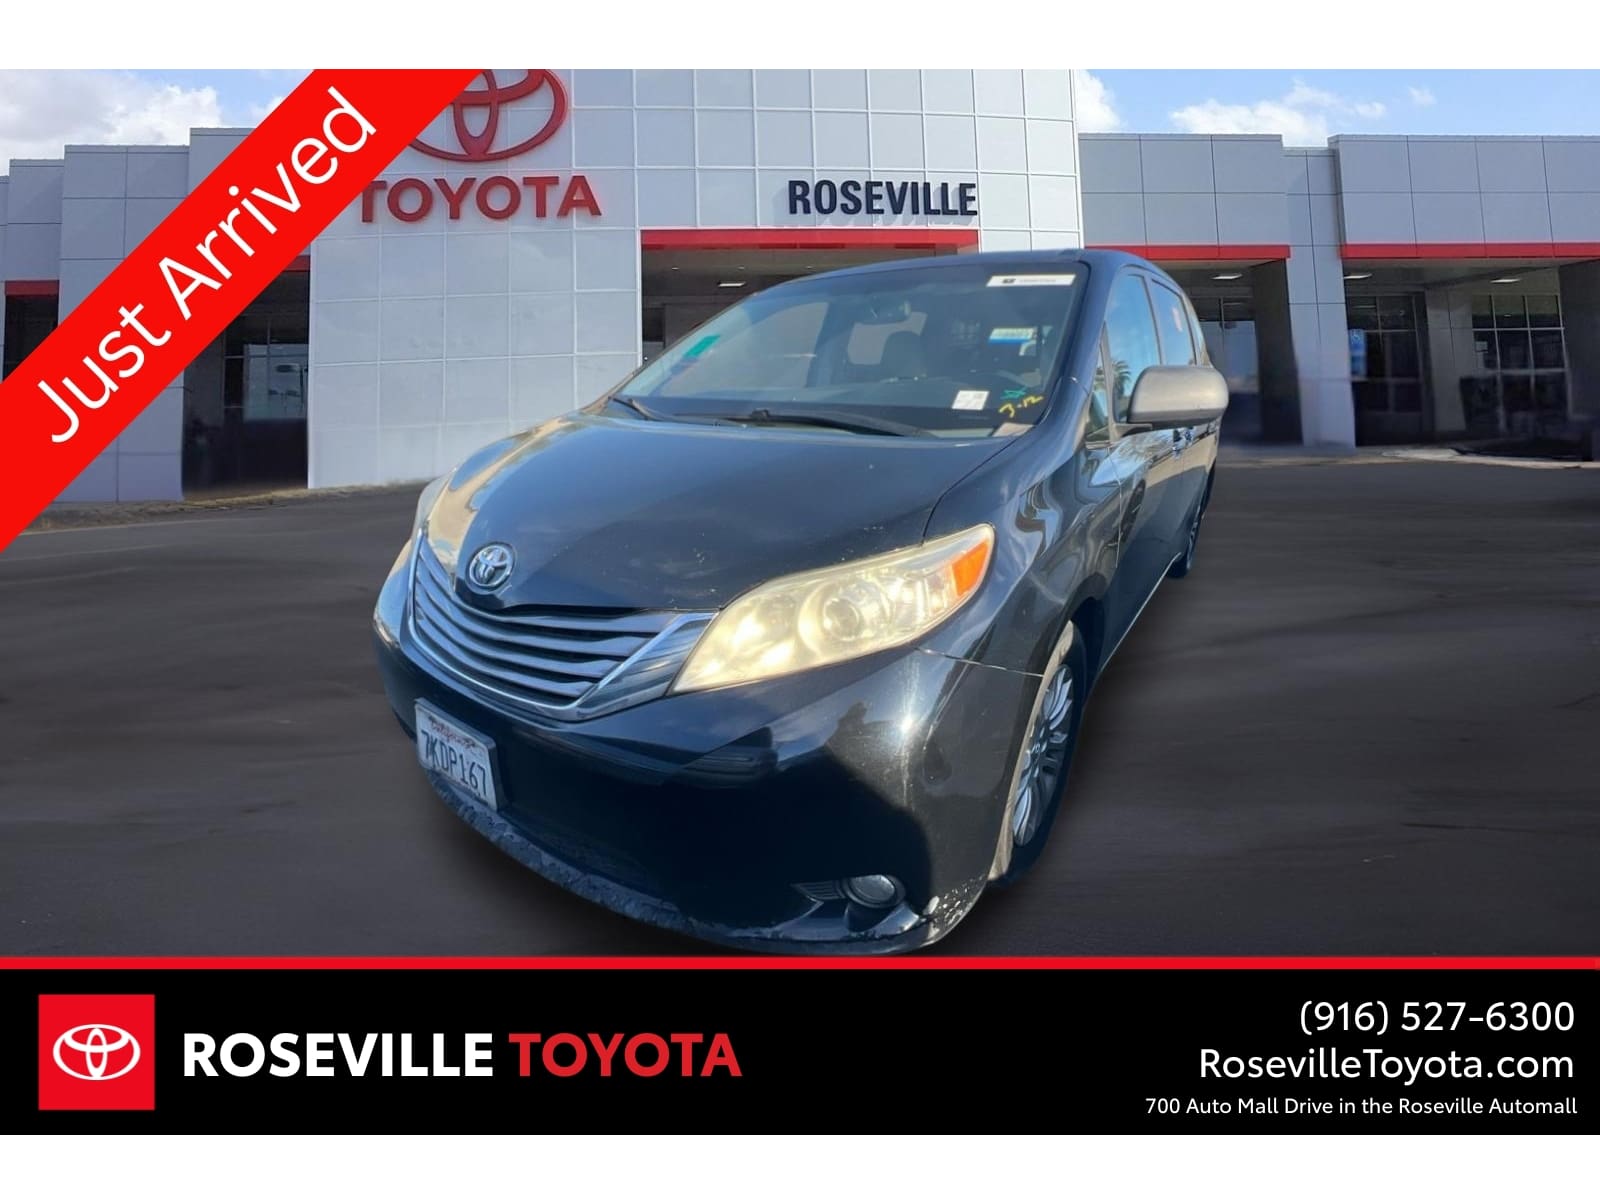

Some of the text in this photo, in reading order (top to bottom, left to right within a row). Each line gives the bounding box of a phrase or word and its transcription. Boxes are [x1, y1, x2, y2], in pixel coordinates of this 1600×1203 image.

[361, 175, 602, 222] TOYOTA
[788, 180, 978, 216] ROSEVILLE
[420, 729, 488, 798] 7KDP167
